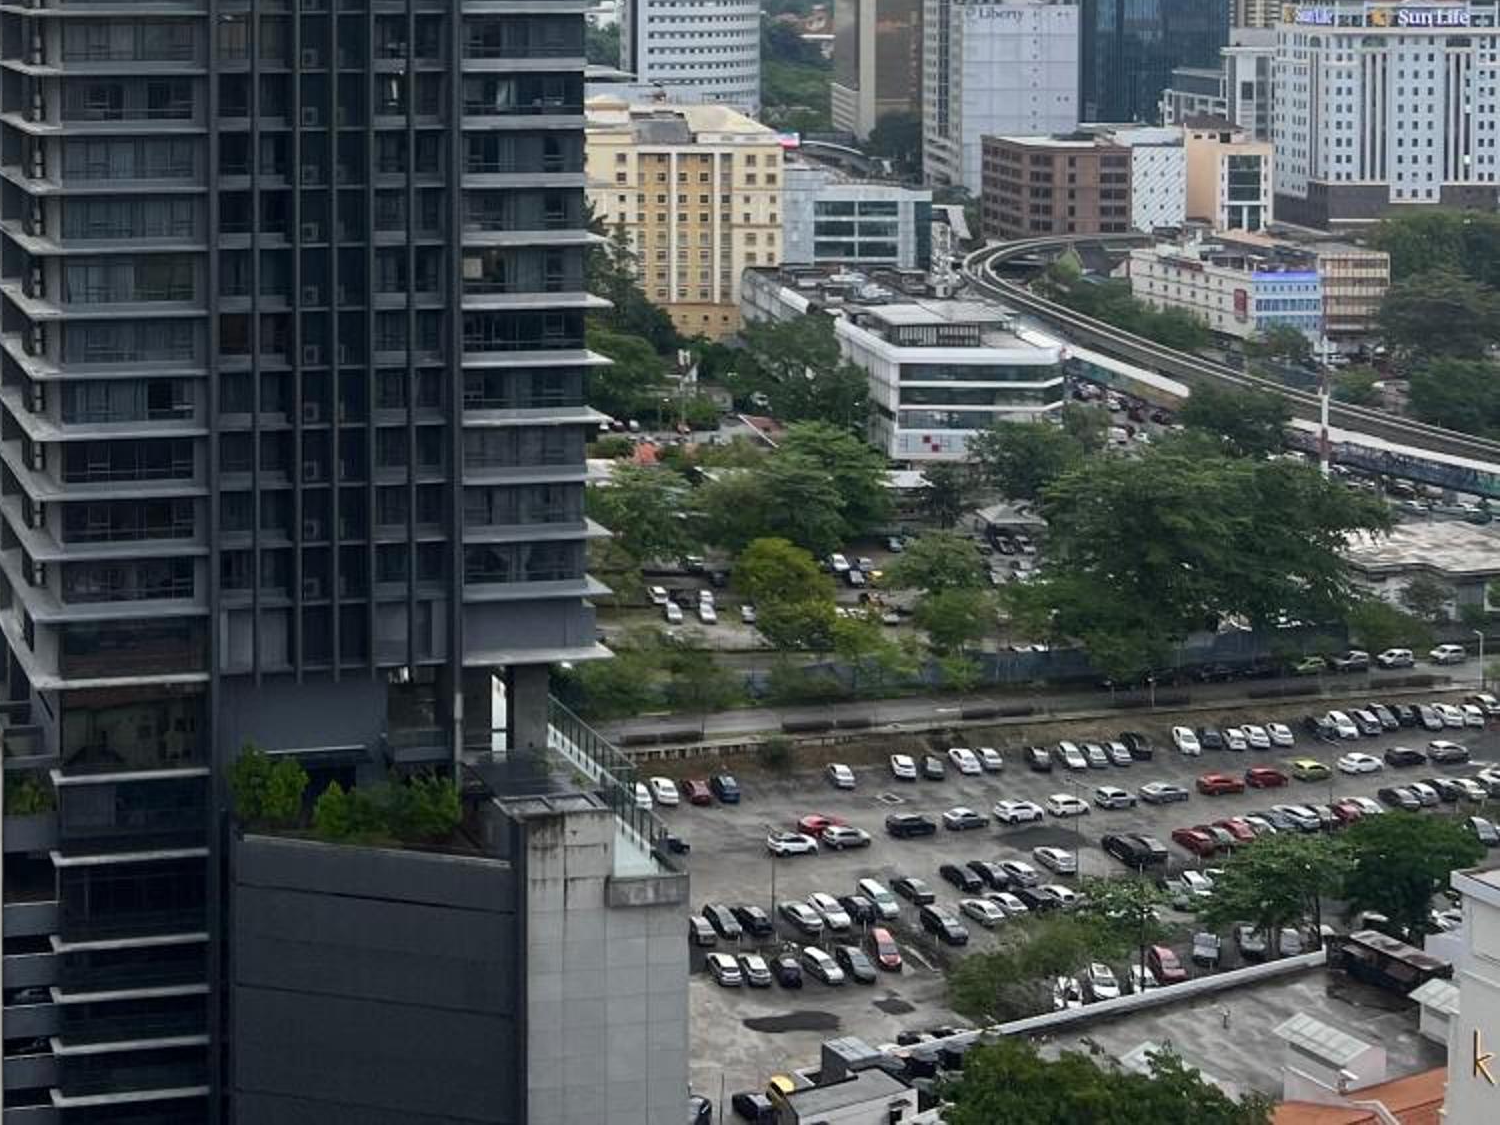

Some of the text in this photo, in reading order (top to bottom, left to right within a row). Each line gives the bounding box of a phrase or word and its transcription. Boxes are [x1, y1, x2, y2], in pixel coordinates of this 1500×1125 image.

[979, 7, 1025, 24] Liberty
[1397, 9, 1470, 24] Sun Life
